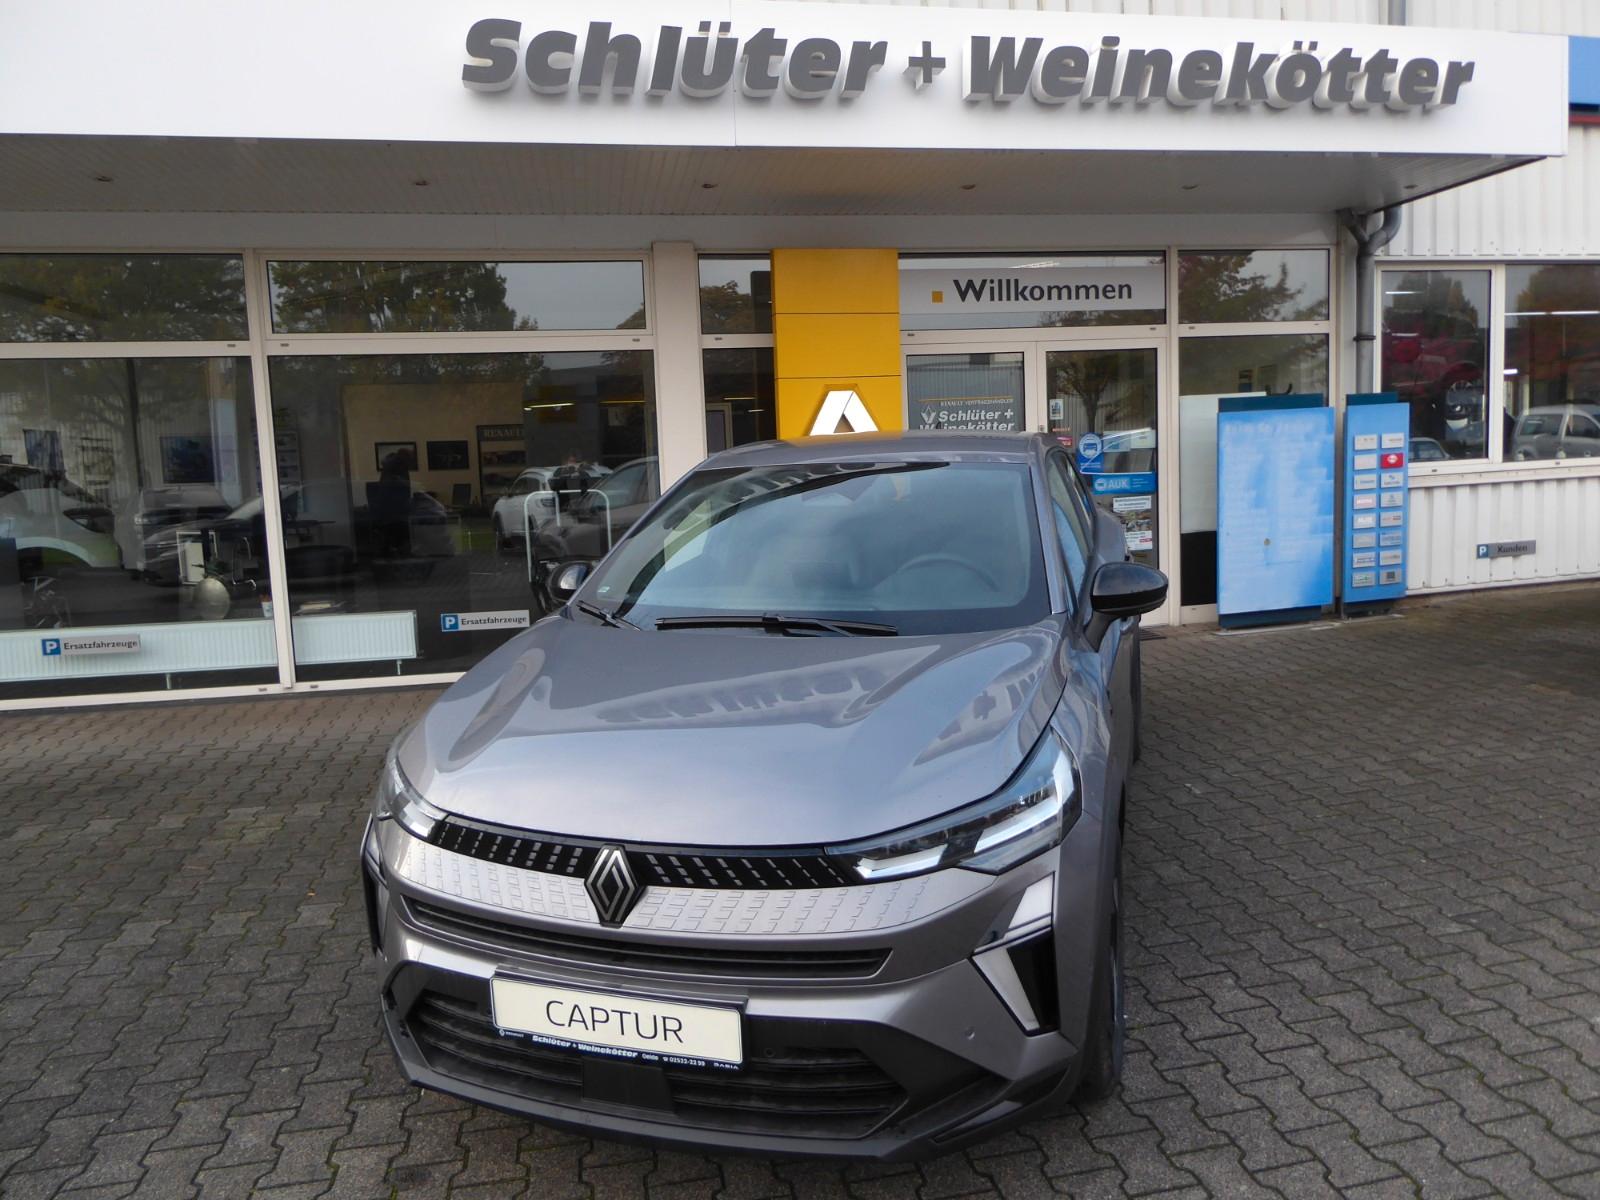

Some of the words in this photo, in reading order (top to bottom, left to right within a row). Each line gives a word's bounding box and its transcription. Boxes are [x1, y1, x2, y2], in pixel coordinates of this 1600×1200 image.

[462, 18, 888, 97] Schlüter
[906, 40, 946, 84] +
[964, 35, 1475, 108] Weinekötter
[953, 278, 1132, 302] Willkommen
[938, 410, 1001, 422] Schlüter
[461, 616, 527, 626] Ersatzfahrzeuge
[63, 640, 138, 650] Ersatzfahrzeuge
[546, 1000, 684, 1043] CAPTUR
[532, 1035, 571, 1048] Schlüter
[578, 1043, 638, 1058] Weinekötter
